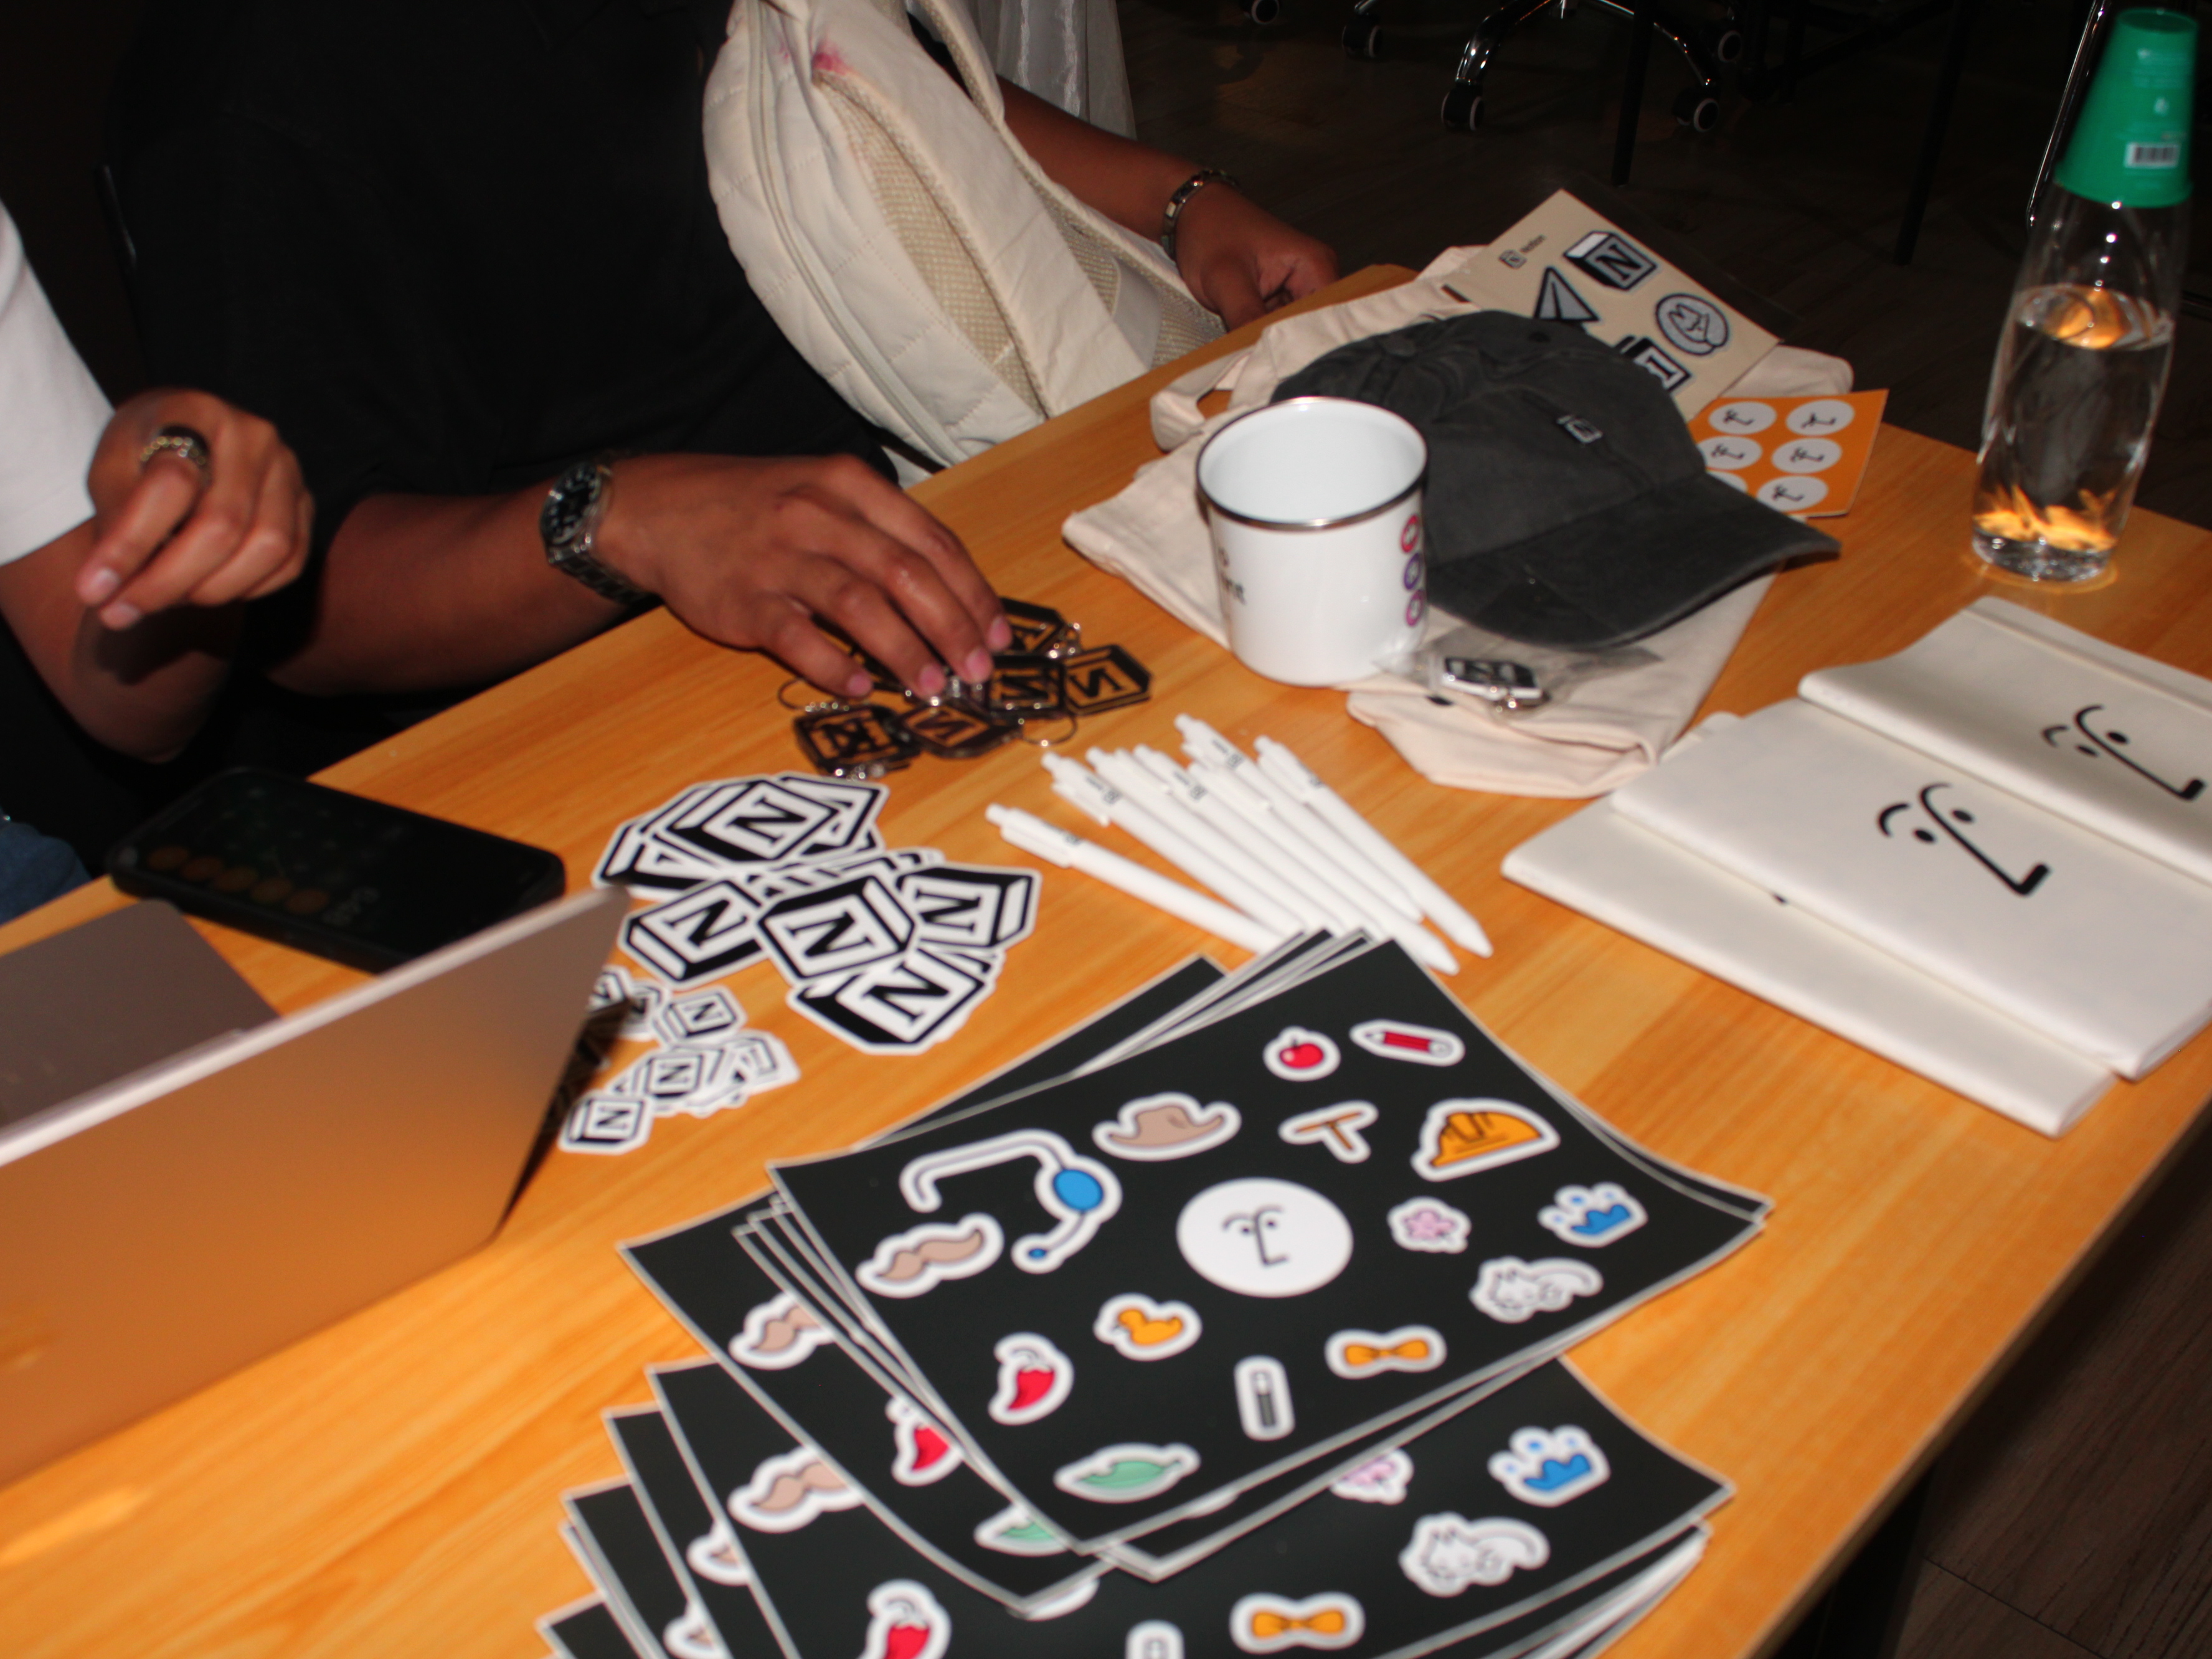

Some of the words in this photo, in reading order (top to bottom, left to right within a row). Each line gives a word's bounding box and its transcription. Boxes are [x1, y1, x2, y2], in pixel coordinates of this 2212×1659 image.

[1595, 243, 1642, 279] N
[724, 795, 808, 846] N
[661, 899, 749, 947] N
[914, 887, 982, 933] N
[783, 910, 877, 958] N
[684, 1001, 724, 1022] N
[861, 960, 951, 1025] N
[658, 1062, 692, 1084] N
[597, 1106, 632, 1129] N
